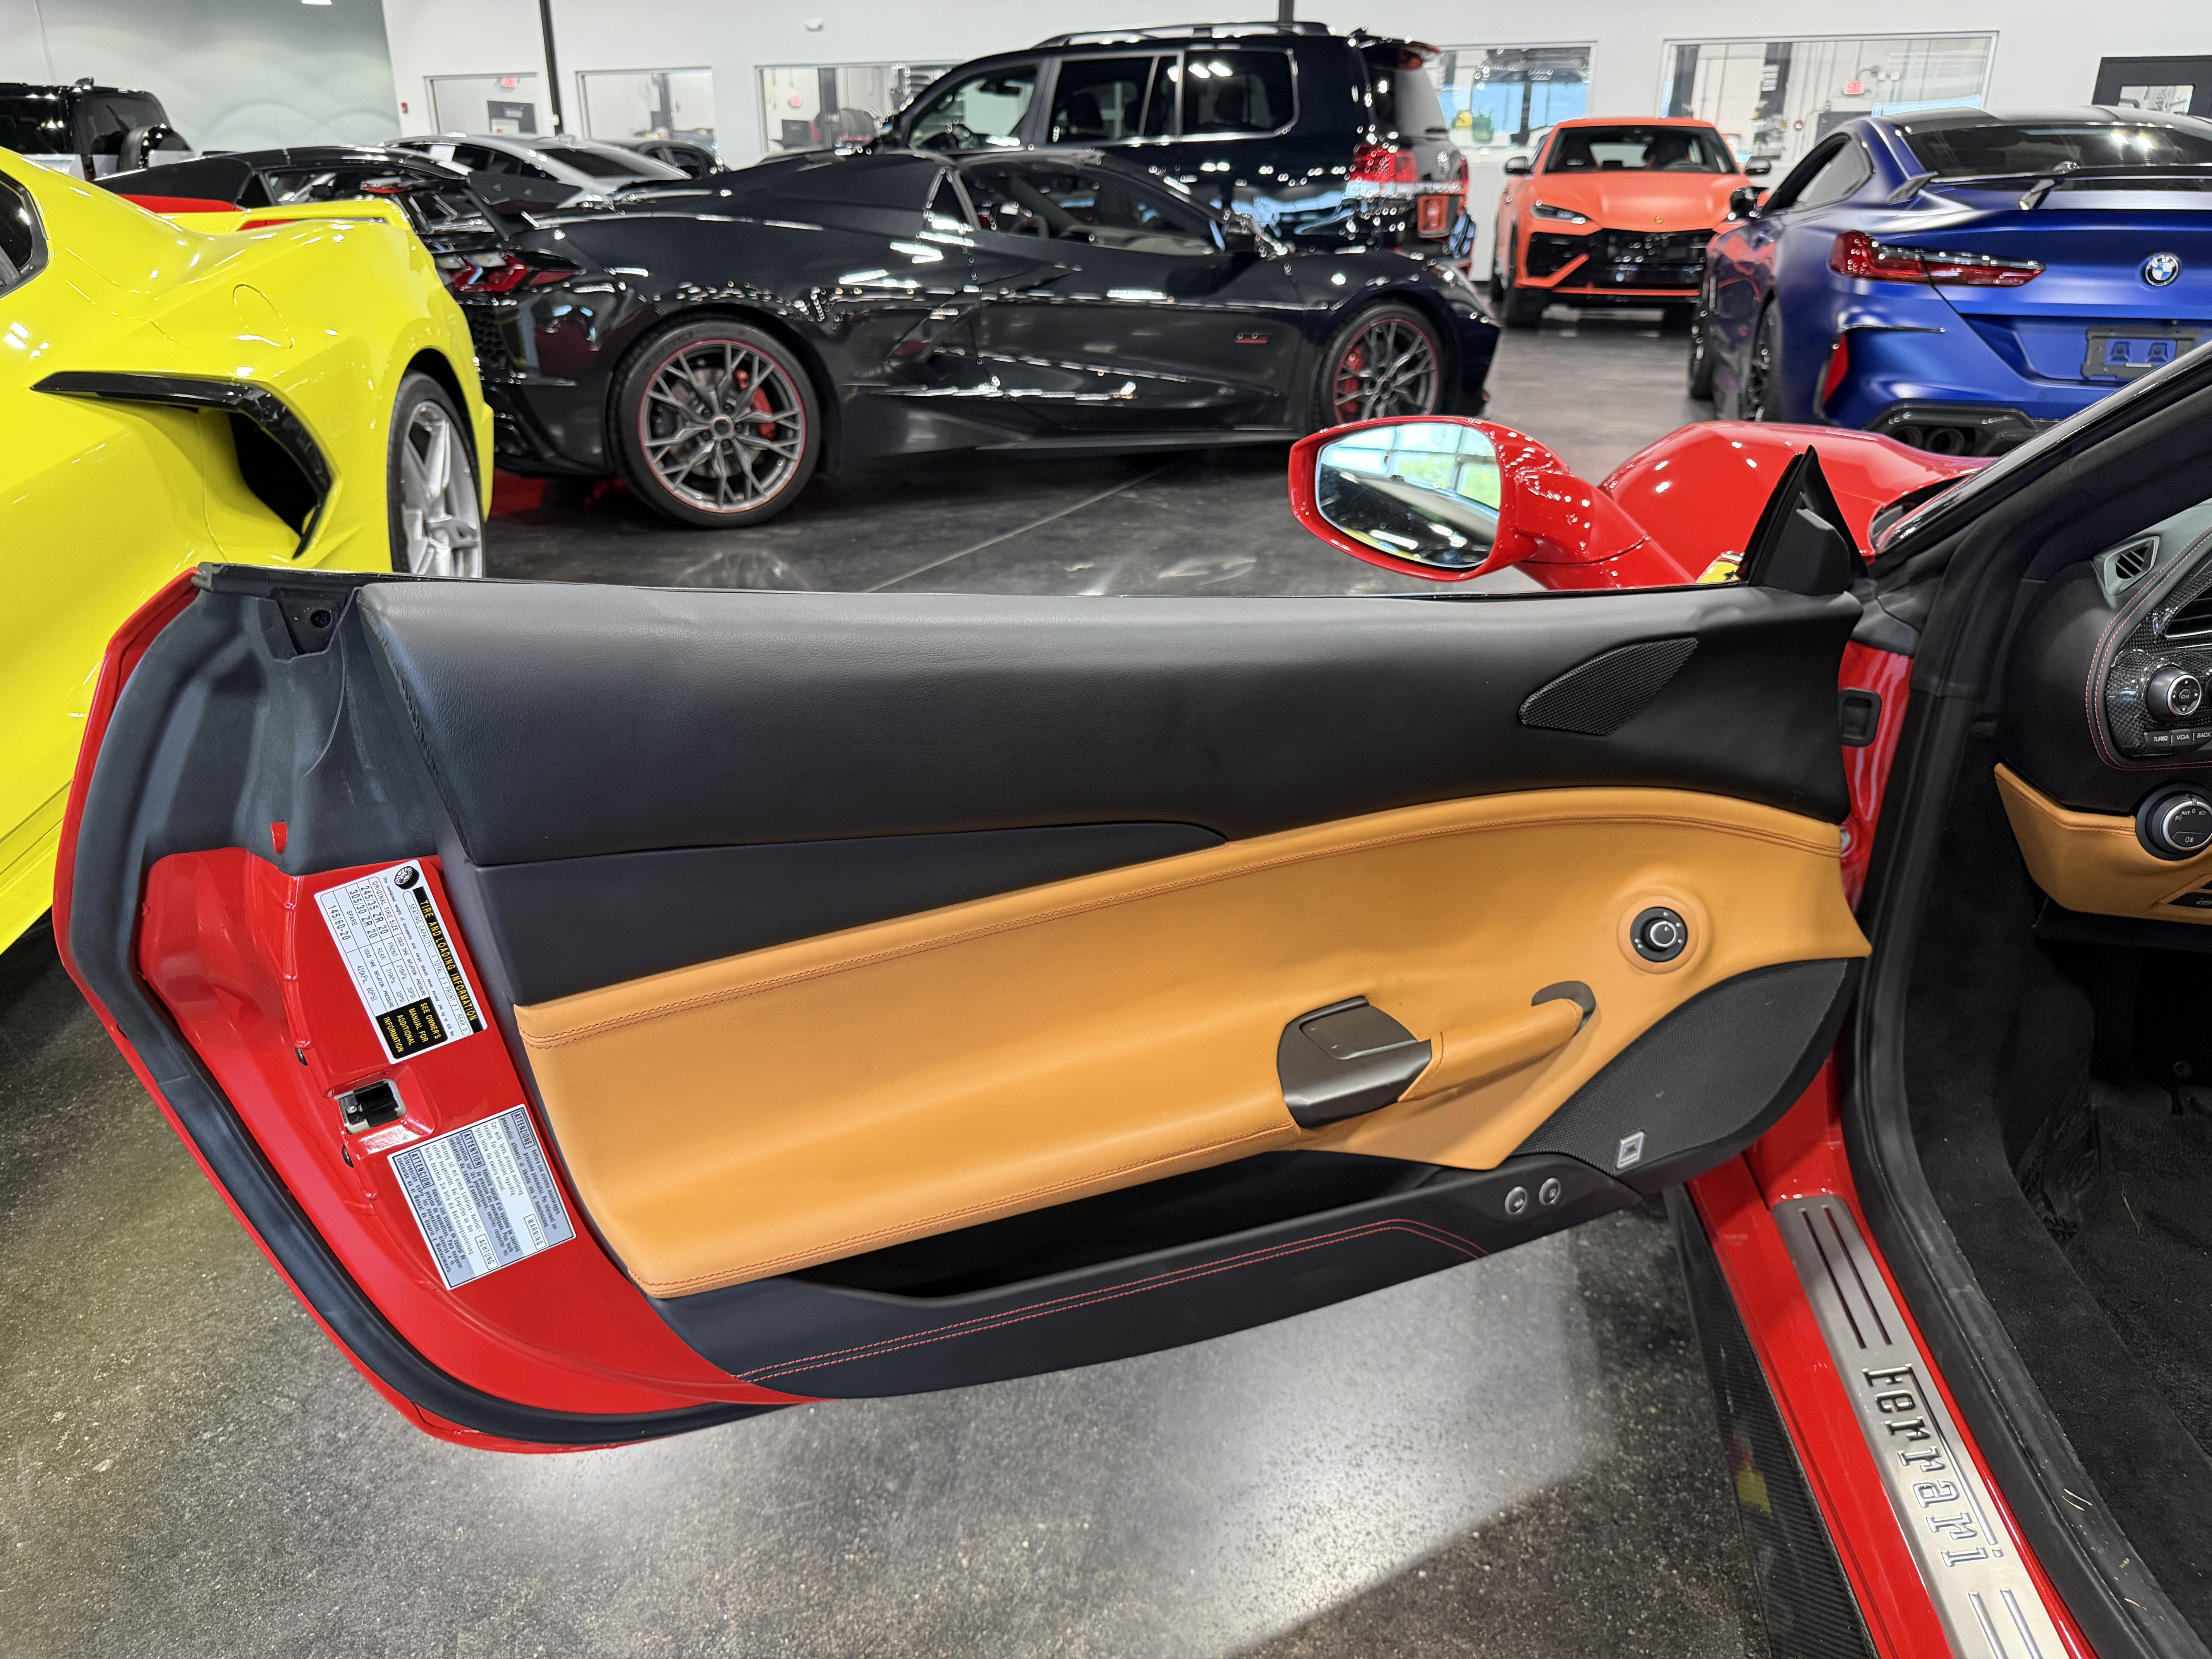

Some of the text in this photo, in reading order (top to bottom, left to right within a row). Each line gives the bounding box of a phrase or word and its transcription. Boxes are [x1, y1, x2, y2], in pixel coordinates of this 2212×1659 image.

[327, 904, 351, 941] 145/60-20
[346, 910, 358, 926] SPARE
[349, 889, 378, 938] 305/30 ZR 20
[360, 885, 389, 934] 245/35 ZR 20
[372, 880, 398, 932] ORIGINAL TIRE SIZE
[386, 885, 397, 902] combined
[393, 903, 402, 915] weight
[402, 922, 413, 940] occupants
[420, 964, 429, 976] should
[376, 947, 386, 960] REAR
[387, 942, 398, 957] FRONT
[397, 936, 405, 946] COLD
[406, 958, 417, 976] INFLATION
[415, 978, 427, 996] PRESSURE
[409, 903, 422, 924] SEATING
[418, 925, 432, 948] CAPACITY
[433, 960, 443, 974] TOTAL
[444, 986, 455, 1001] FRONT
[456, 1013, 465, 1026] REAR
[419, 900, 477, 1022] TIRE AND LOADING INFORMATION
[363, 948, 372, 958] COLD
[373, 970, 385, 988] INFLATION
[382, 990, 394, 1008] PRESSURE
[366, 986, 378, 1001] 60PSI
[395, 990, 405, 1003] 30PSI
[406, 986, 416, 999] 30PSI
[383, 1016, 404, 1053] INFORMATION
[396, 1013, 416, 1046] ADDITIONAL
[408, 1007, 429, 1042] MANUAL FOR
[419, 1001, 441, 1039] SEE OWNER'S
[513, 1112, 532, 1146] ATTENZIONE
[424, 1147, 434, 1161] Reifen
[438, 1140, 452, 1161] Fahrzeug
[451, 1169, 459, 1177] mit
[455, 1177, 464, 1191] einem
[463, 1132, 483, 1166] ATTENTION
[474, 1127, 484, 1139] tyres
[480, 1139, 490, 1152] follow
[488, 1160, 499, 1175] owners
[490, 1121, 525, 1195] Car with tyres pressure monitoring
[500, 1116, 515, 1140] pneumatici
[510, 1141, 523, 1160] attenersi
[521, 1168, 532, 1184] libretto
[522, 1152, 535, 1173] pressione
[410, 1151, 434, 1187] ATTENCIÓN
[430, 1162, 443, 1181] beachten
[431, 1144, 443, 1159] system
[451, 1187, 459, 1195] Bei
[493, 1149, 509, 1176] interventions
[503, 1175, 517, 1196] regarding
[531, 1148, 542, 1164] Vettura
[540, 1172, 551, 1188] sistema
[443, 1190, 452, 1201] bitte
[447, 1201, 455, 1209] die
[527, 1218, 543, 1245] WARNING
[478, 1238, 495, 1265] ACHTUNG
[1862, 1363, 2004, 1567] Ferrari
